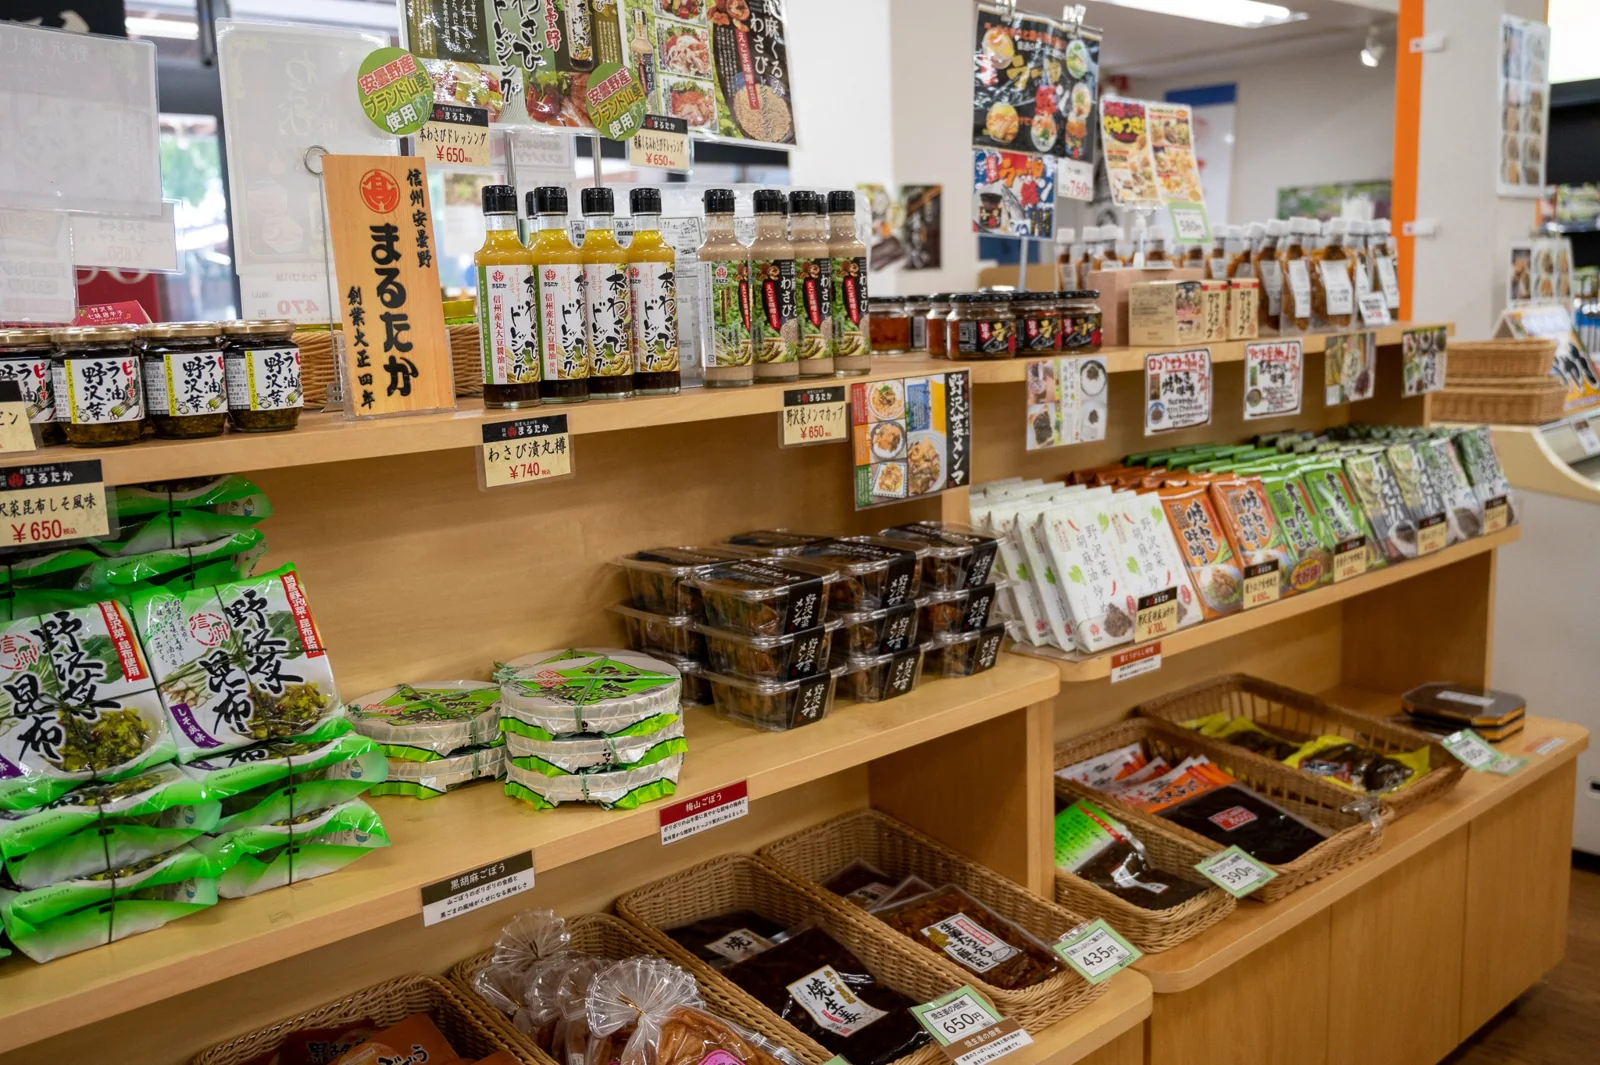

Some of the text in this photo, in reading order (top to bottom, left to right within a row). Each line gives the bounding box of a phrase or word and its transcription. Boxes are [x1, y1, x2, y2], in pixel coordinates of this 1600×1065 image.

[359, 53, 417, 95] 安曇野産
[364, 70, 431, 118] ブランド山葵
[587, 67, 633, 107] 安曇野産
[385, 103, 418, 133] 使用
[591, 80, 646, 128] ブランド山葵
[608, 114, 634, 139] 使用
[420, 127, 487, 146] 本わさびドレッシング
[407, 168, 432, 268] 信州安曇野
[369, 222, 419, 397] まるたか
[606, 270, 628, 354] 本わさび
[658, 268, 676, 349] 本わさび
[347, 286, 376, 409] 創業大正四年
[510, 304, 528, 380] ドレッシング
[562, 303, 579, 376] ドレッシング
[592, 302, 609, 373] ドレッシング
[643, 300, 660, 370] ドレッシング
[82, 362, 107, 420] 野沢菜
[105, 360, 126, 401] ラー油
[183, 355, 205, 413] 野沢菜
[204, 355, 221, 394] ラー油
[264, 352, 285, 407] 野沢菜
[283, 351, 298, 389] ラー油
[518, 423, 549, 436] まるたか
[786, 406, 844, 427] 野沢菜メンマカップ
[949, 374, 965, 484] 野沢菜メンマ
[488, 436, 567, 462] わさび漬丸樽
[25, 470, 74, 485] まるたか
[1085, 524, 1111, 577] 野沢菜
[1132, 527, 1159, 590] 胡麻油炒
[189, 613, 229, 645] 信州
[222, 588, 304, 695] 野沢菜
[30, 611, 121, 720] 野沢菜
[199, 650, 251, 735] 昆布
[3, 673, 62, 761] 昆布
[177, 708, 207, 743] しそ風味
[685, 793, 722, 812] 梅山ごぼう
[447, 875, 518, 905] 山ごぼうのポリポリの食感と
[450, 863, 505, 891] 黒胡麻ごぼう
[805, 977, 863, 1025] 焼生姜
[943, 1011, 985, 1034] 650円
